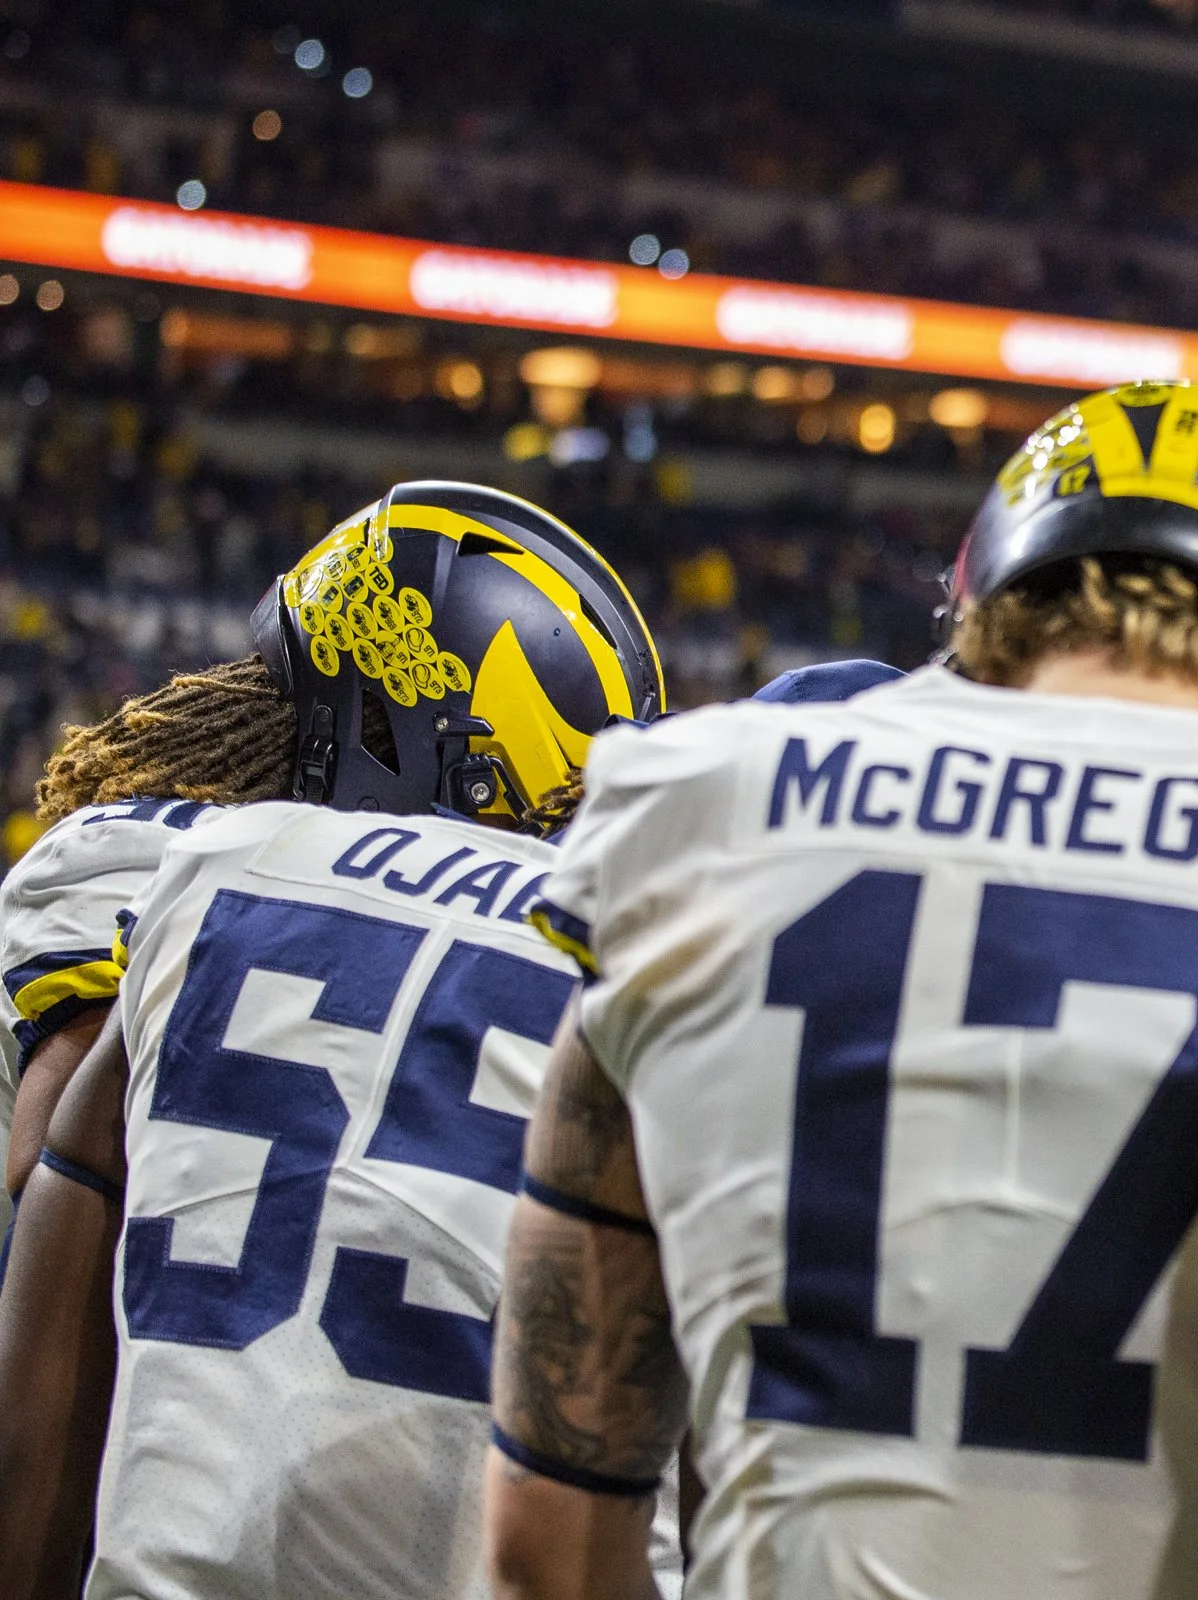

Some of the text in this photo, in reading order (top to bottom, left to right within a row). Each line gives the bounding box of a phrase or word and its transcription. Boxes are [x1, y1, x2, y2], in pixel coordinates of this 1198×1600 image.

[369, 565, 389, 591] TED
[411, 610, 424, 624] 972
[396, 651, 408, 665] 971
[423, 645, 436, 658] 971
[430, 680, 443, 695] 973
[123, 888, 583, 1403] 55
